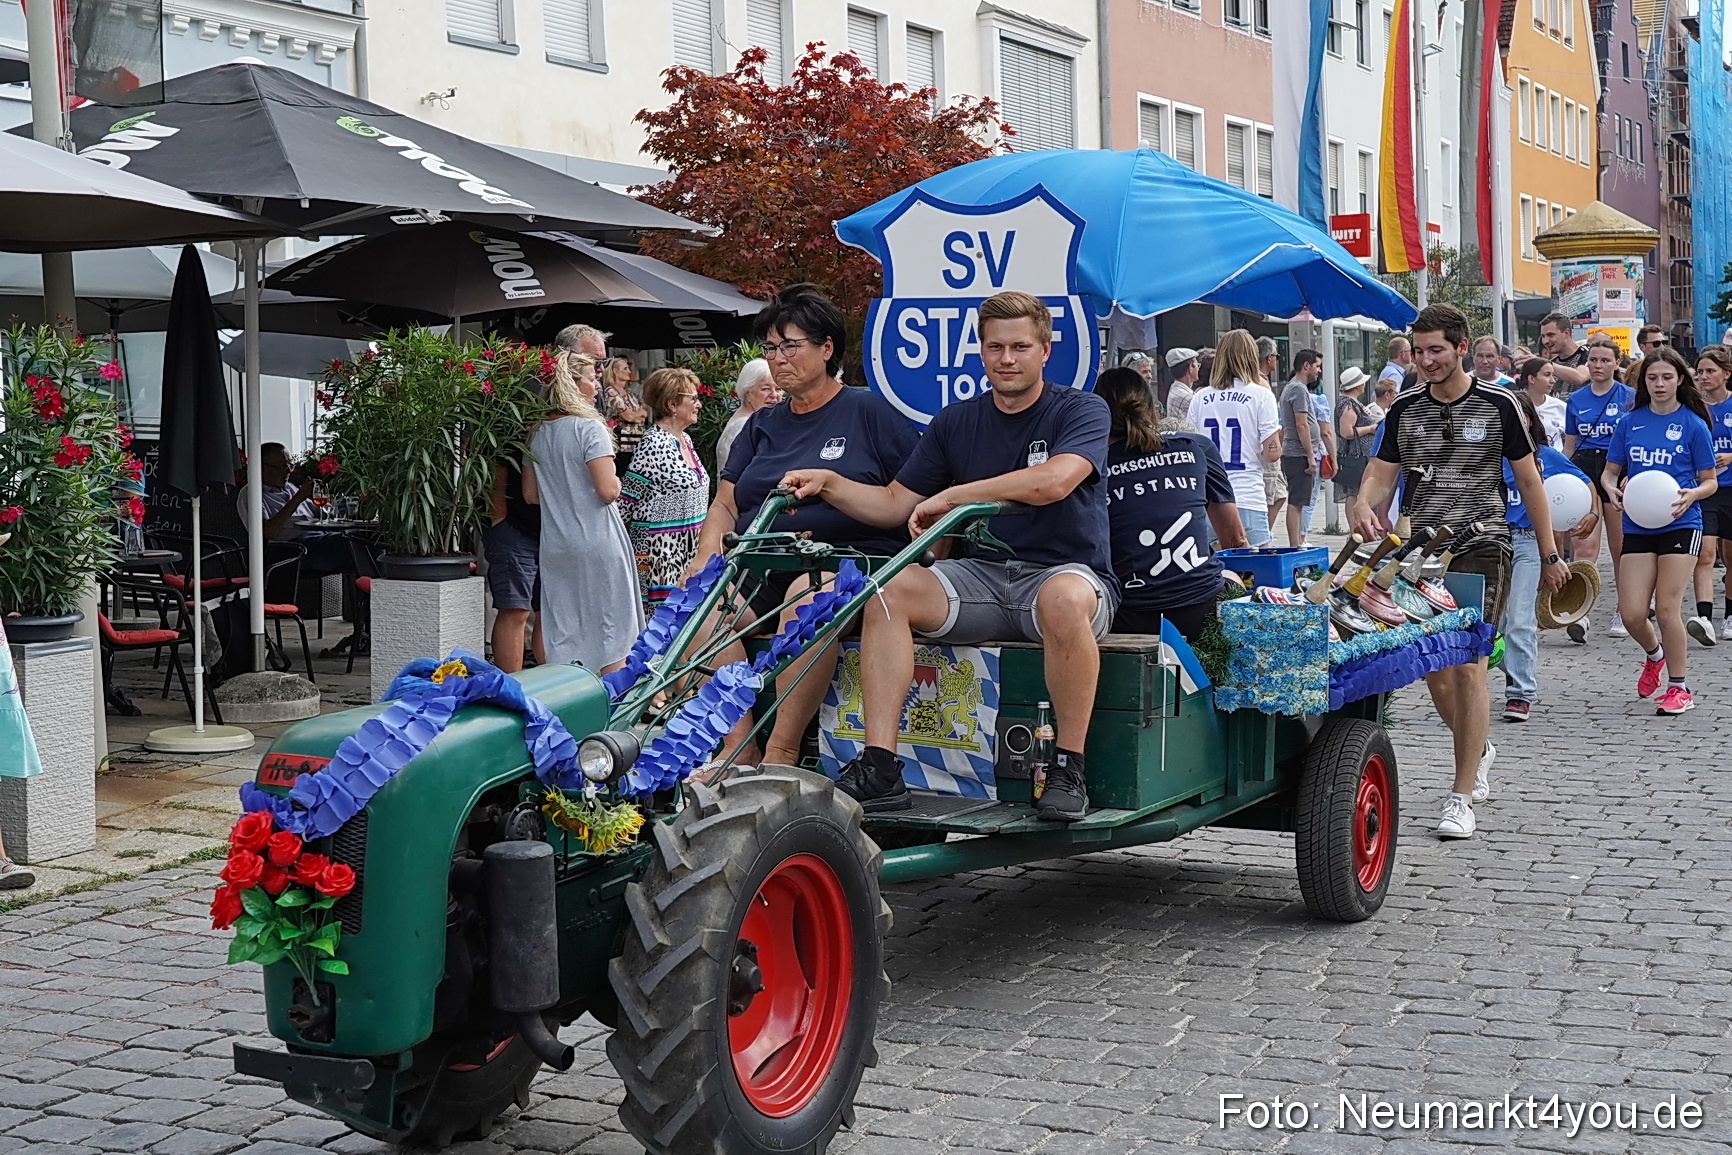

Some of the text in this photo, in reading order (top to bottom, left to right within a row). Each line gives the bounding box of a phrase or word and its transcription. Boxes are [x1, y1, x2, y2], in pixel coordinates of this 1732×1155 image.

[1331, 229, 1362, 240] WITT
[942, 230, 1017, 289] SV
[897, 306, 1065, 369] STAF
[1203, 391, 1252, 405] SV STAUF
[1577, 423, 1614, 438] Elyth
[1204, 418, 1247, 471] 11
[1629, 446, 1673, 467] Elyth
[1133, 477, 1198, 496] STAUF
